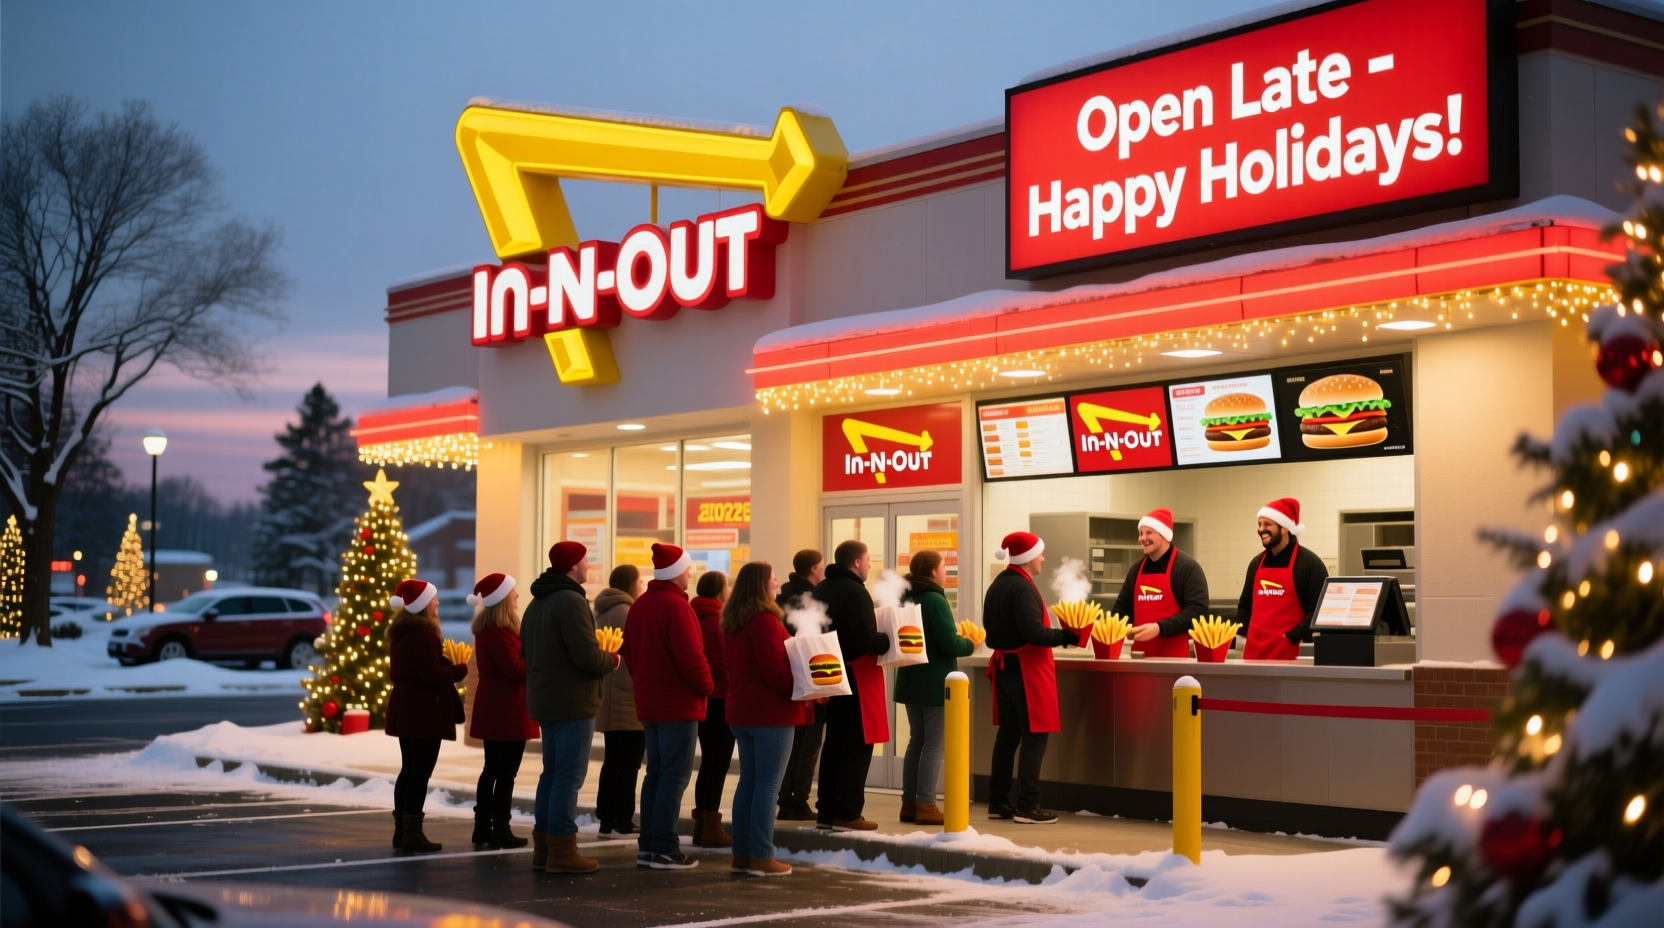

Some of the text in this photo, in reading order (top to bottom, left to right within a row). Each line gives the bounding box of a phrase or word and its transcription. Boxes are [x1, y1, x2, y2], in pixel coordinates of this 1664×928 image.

[1028, 93, 1463, 241] Happy Holidays!
[1076, 84, 1214, 160] Open
[1230, 48, 1352, 120] Late
